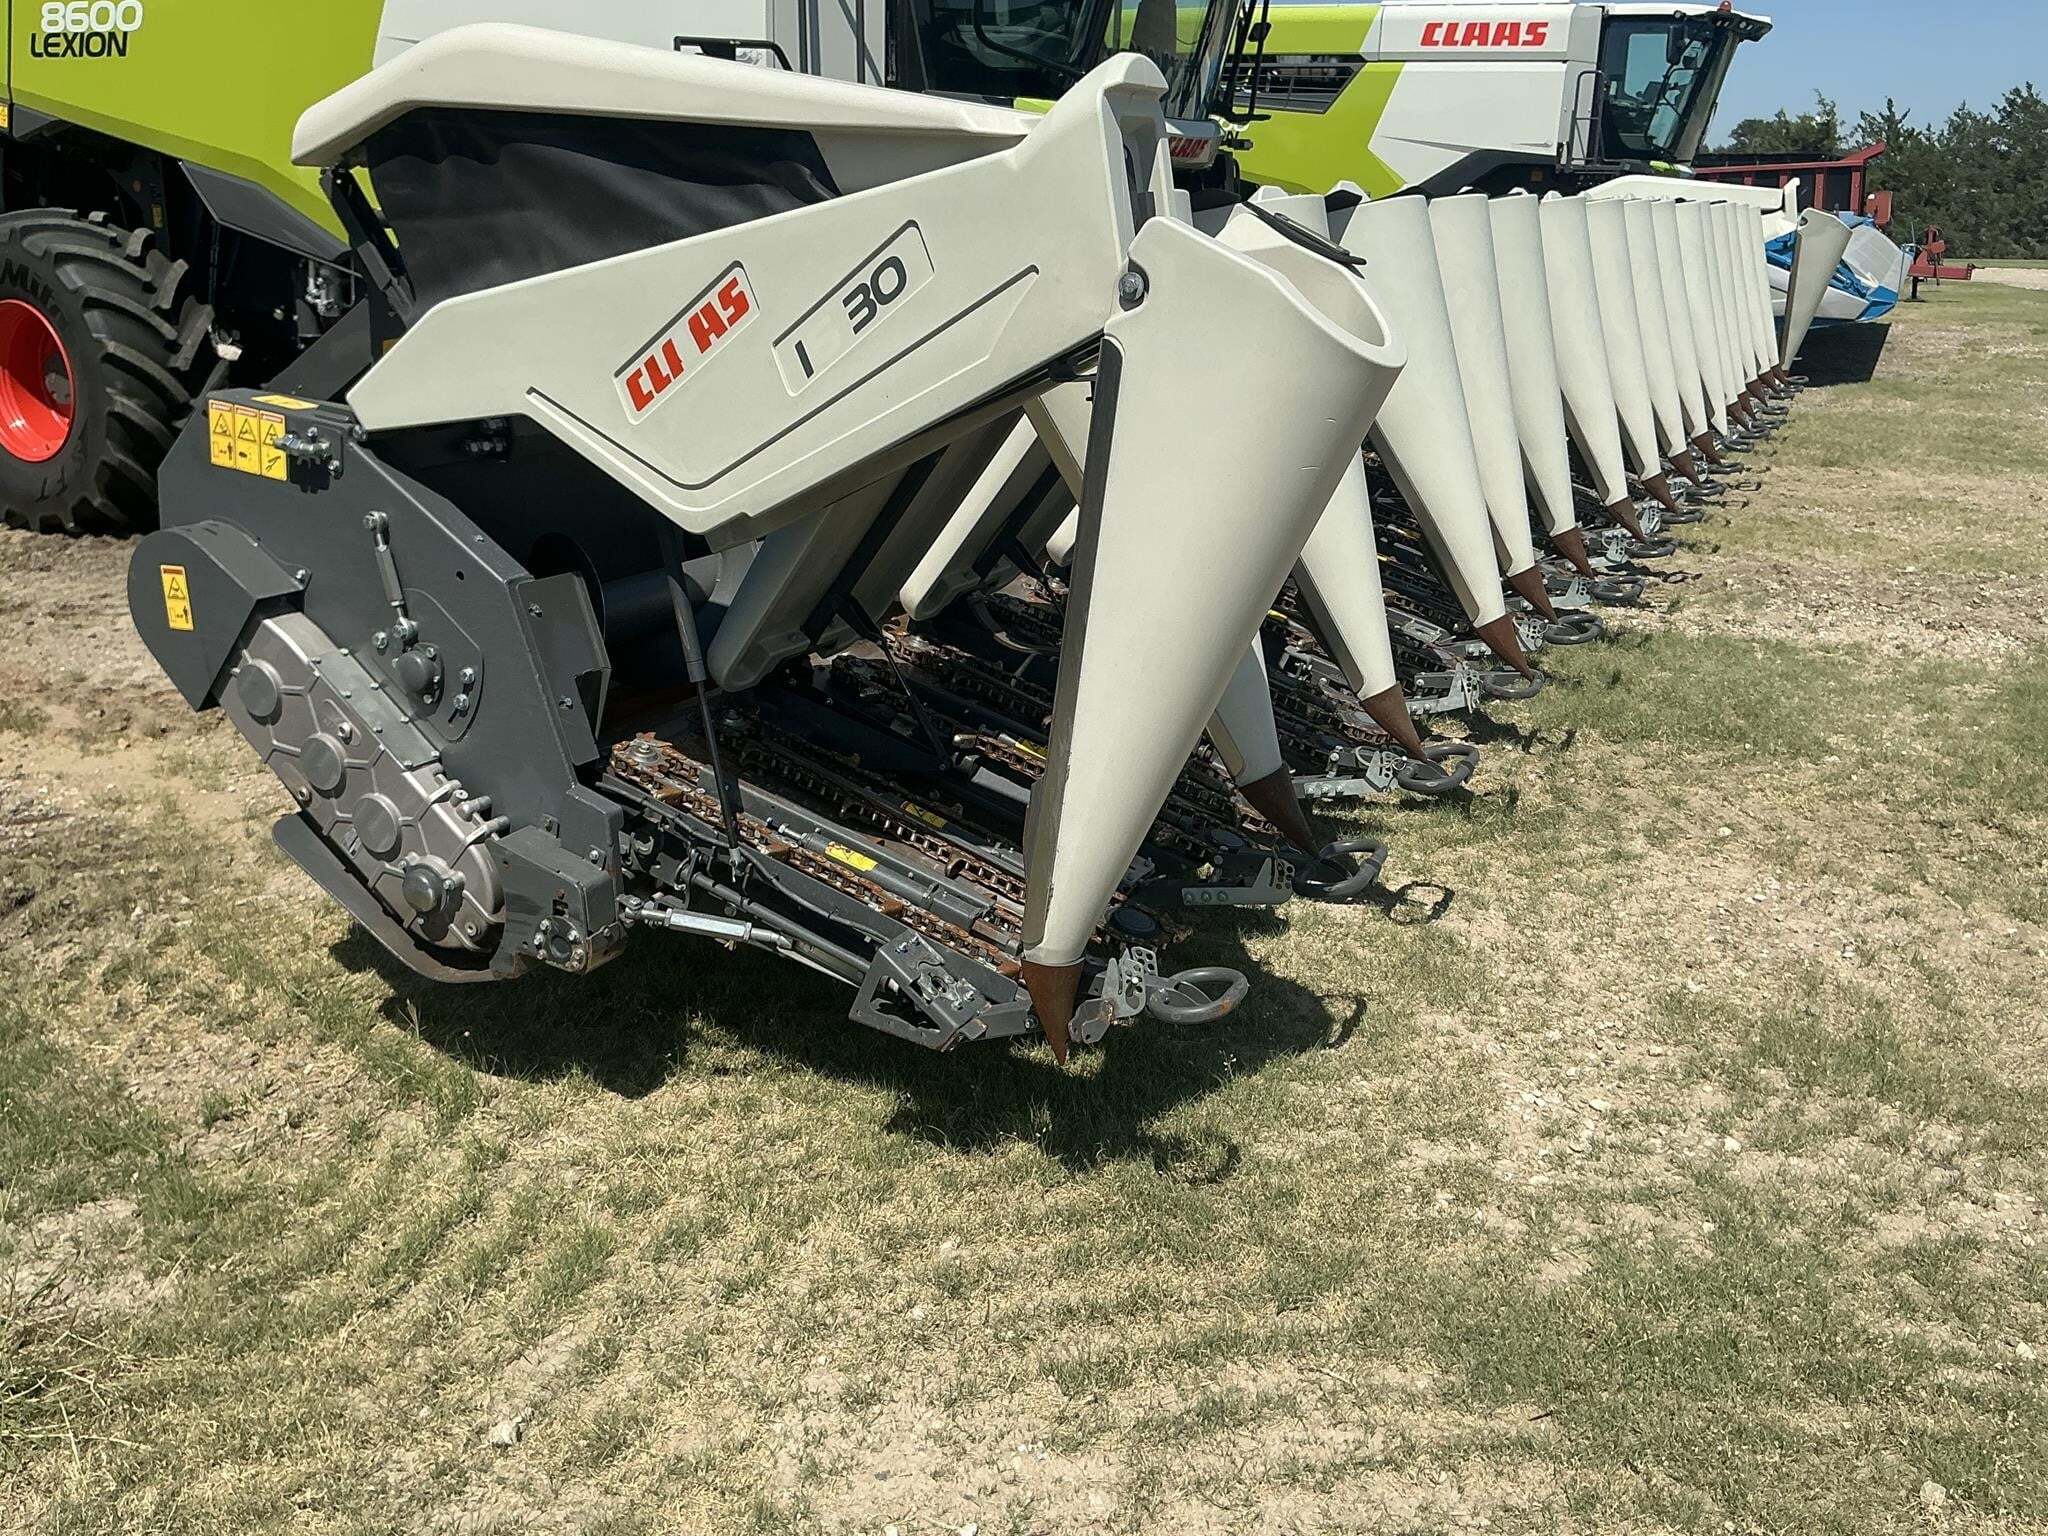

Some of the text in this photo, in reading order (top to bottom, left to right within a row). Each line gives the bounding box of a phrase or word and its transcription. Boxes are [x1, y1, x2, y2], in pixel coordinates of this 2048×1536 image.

[41, 0, 143, 33] 8600
[31, 32, 128, 57] LEXION
[1420, 22, 1549, 46] CLAAS
[842, 255, 907, 335] 30
